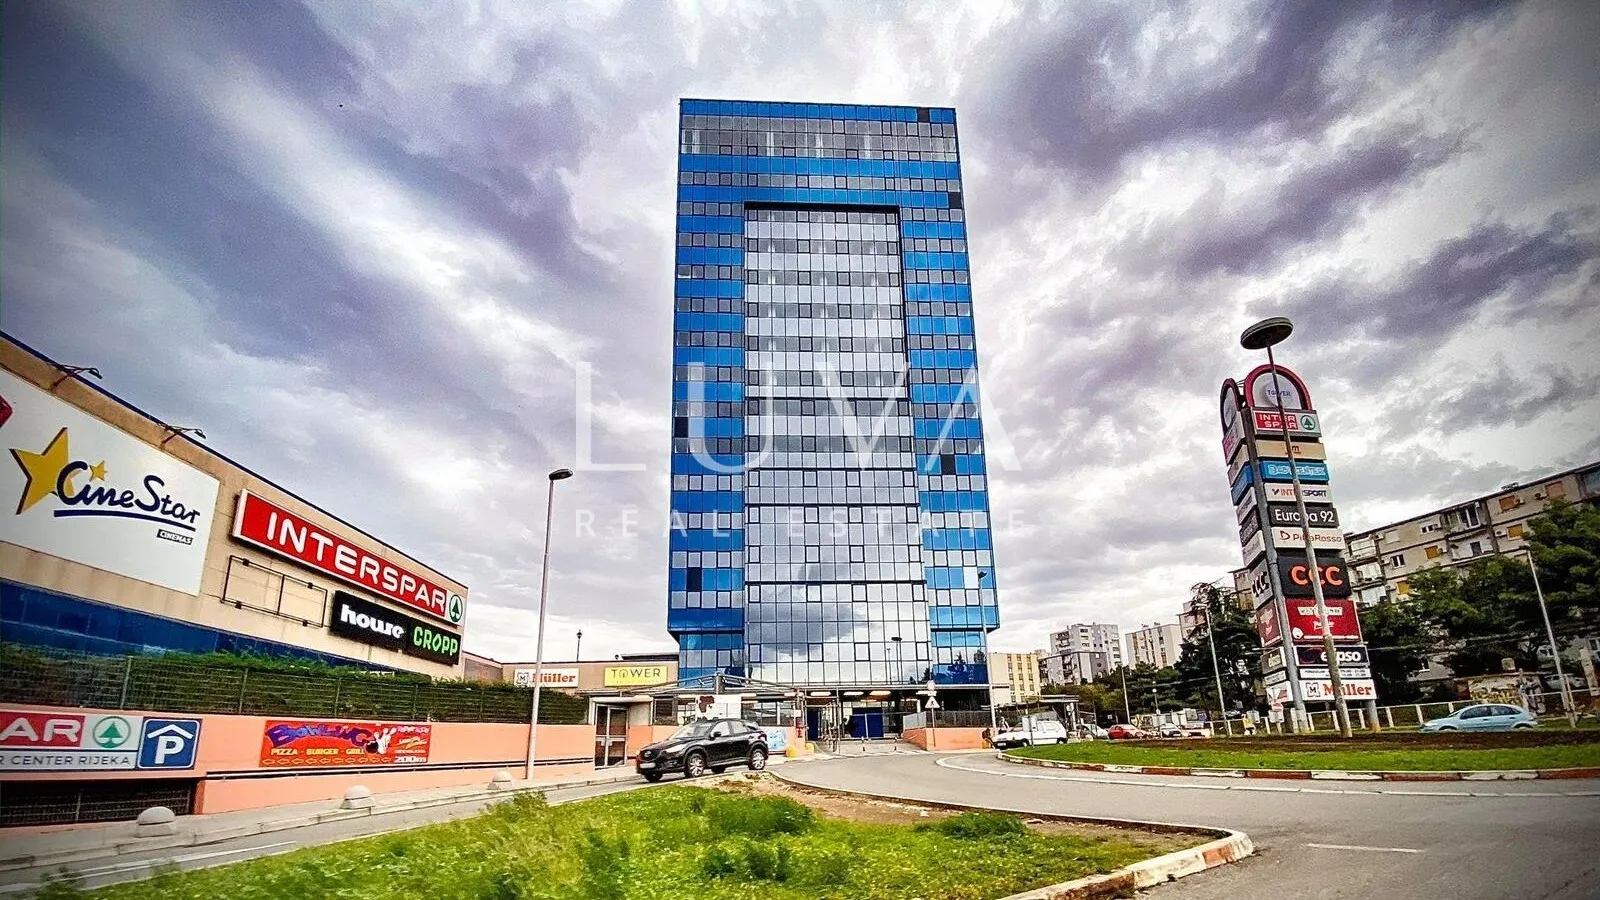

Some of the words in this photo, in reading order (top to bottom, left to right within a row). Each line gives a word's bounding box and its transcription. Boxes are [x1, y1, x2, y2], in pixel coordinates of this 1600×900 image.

[57, 460, 201, 524] CineStar
[1280, 488, 1327, 497] INTSPORT
[1320, 511, 1335, 523] 92
[159, 530, 193, 545] CINEMAS
[1293, 533, 1342, 543] PiaRosso
[267, 512, 447, 614] INTERSPAR
[413, 626, 459, 656] CROPP
[1321, 651, 1361, 662] epso
[611, 667, 661, 679] TOWER
[1323, 683, 1372, 696] Mller
[154, 736, 184, 764] P
[271, 748, 298, 756] PIZZA
[306, 748, 339, 756] BURGER
[11, 755, 73, 766] CENTER
[78, 755, 130, 766] RIJEKA
